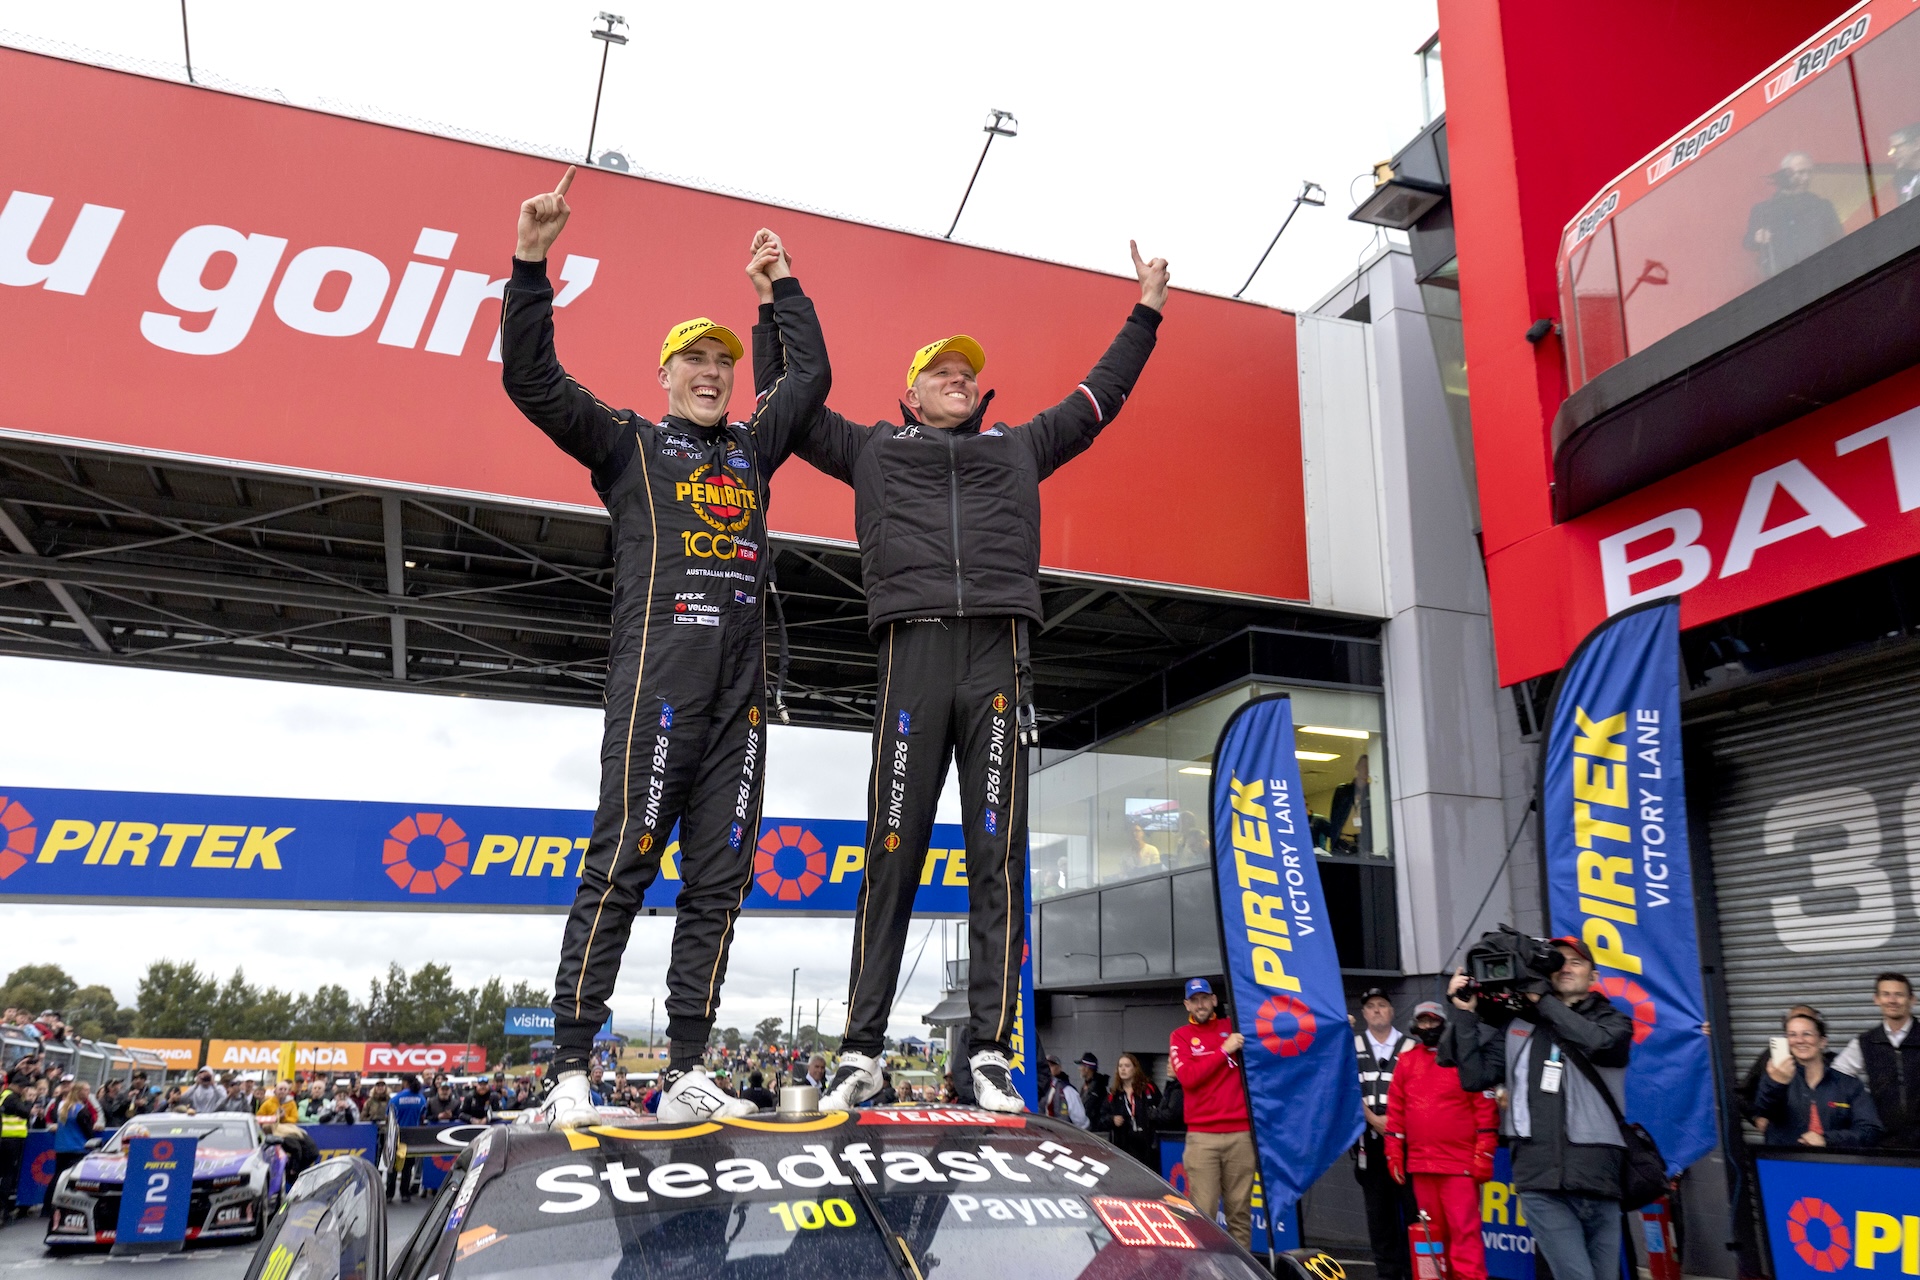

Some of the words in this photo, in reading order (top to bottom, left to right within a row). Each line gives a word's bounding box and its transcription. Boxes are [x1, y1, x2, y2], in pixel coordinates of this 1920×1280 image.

[1793, 13, 1872, 83] Repco
[1670, 110, 1734, 168] Repco
[1576, 190, 1620, 242] Repco
[661, 448, 703, 459] GROVE
[675, 481, 758, 511] PENRITE
[681, 530, 738, 560] 100
[685, 568, 724, 578] AUSTRALIAN
[674, 592, 707, 601] HRX
[652, 734, 670, 775] 1926
[742, 728, 759, 781] SINCE
[892, 740, 909, 778] 1926
[990, 715, 1006, 766] SINCE
[1635, 708, 1662, 781] LANE
[644, 775, 664, 830] SINCE
[735, 780, 751, 820] 1926
[887, 779, 905, 830] SINCE
[986, 767, 1001, 805] 1926
[1269, 778, 1296, 836] LANE
[36, 819, 297, 870] PIRTEK
[1572, 704, 1644, 976] PIRTEK
[1638, 787, 1671, 909] VICTORY
[1229, 768, 1303, 994] PIRTEK
[1279, 840, 1316, 939] VICTORY
[1764, 784, 1920, 953] 3
[513, 1013, 556, 1028] visitns
[222, 1046, 349, 1065] ANACNDA
[369, 1048, 447, 1066] RYCO
[874, 1111, 997, 1124] YEARS
[145, 1172, 170, 1204] 2
[534, 1141, 1032, 1214] Steadfast
[769, 1198, 857, 1232] 100
[947, 1194, 1088, 1227] Payne
